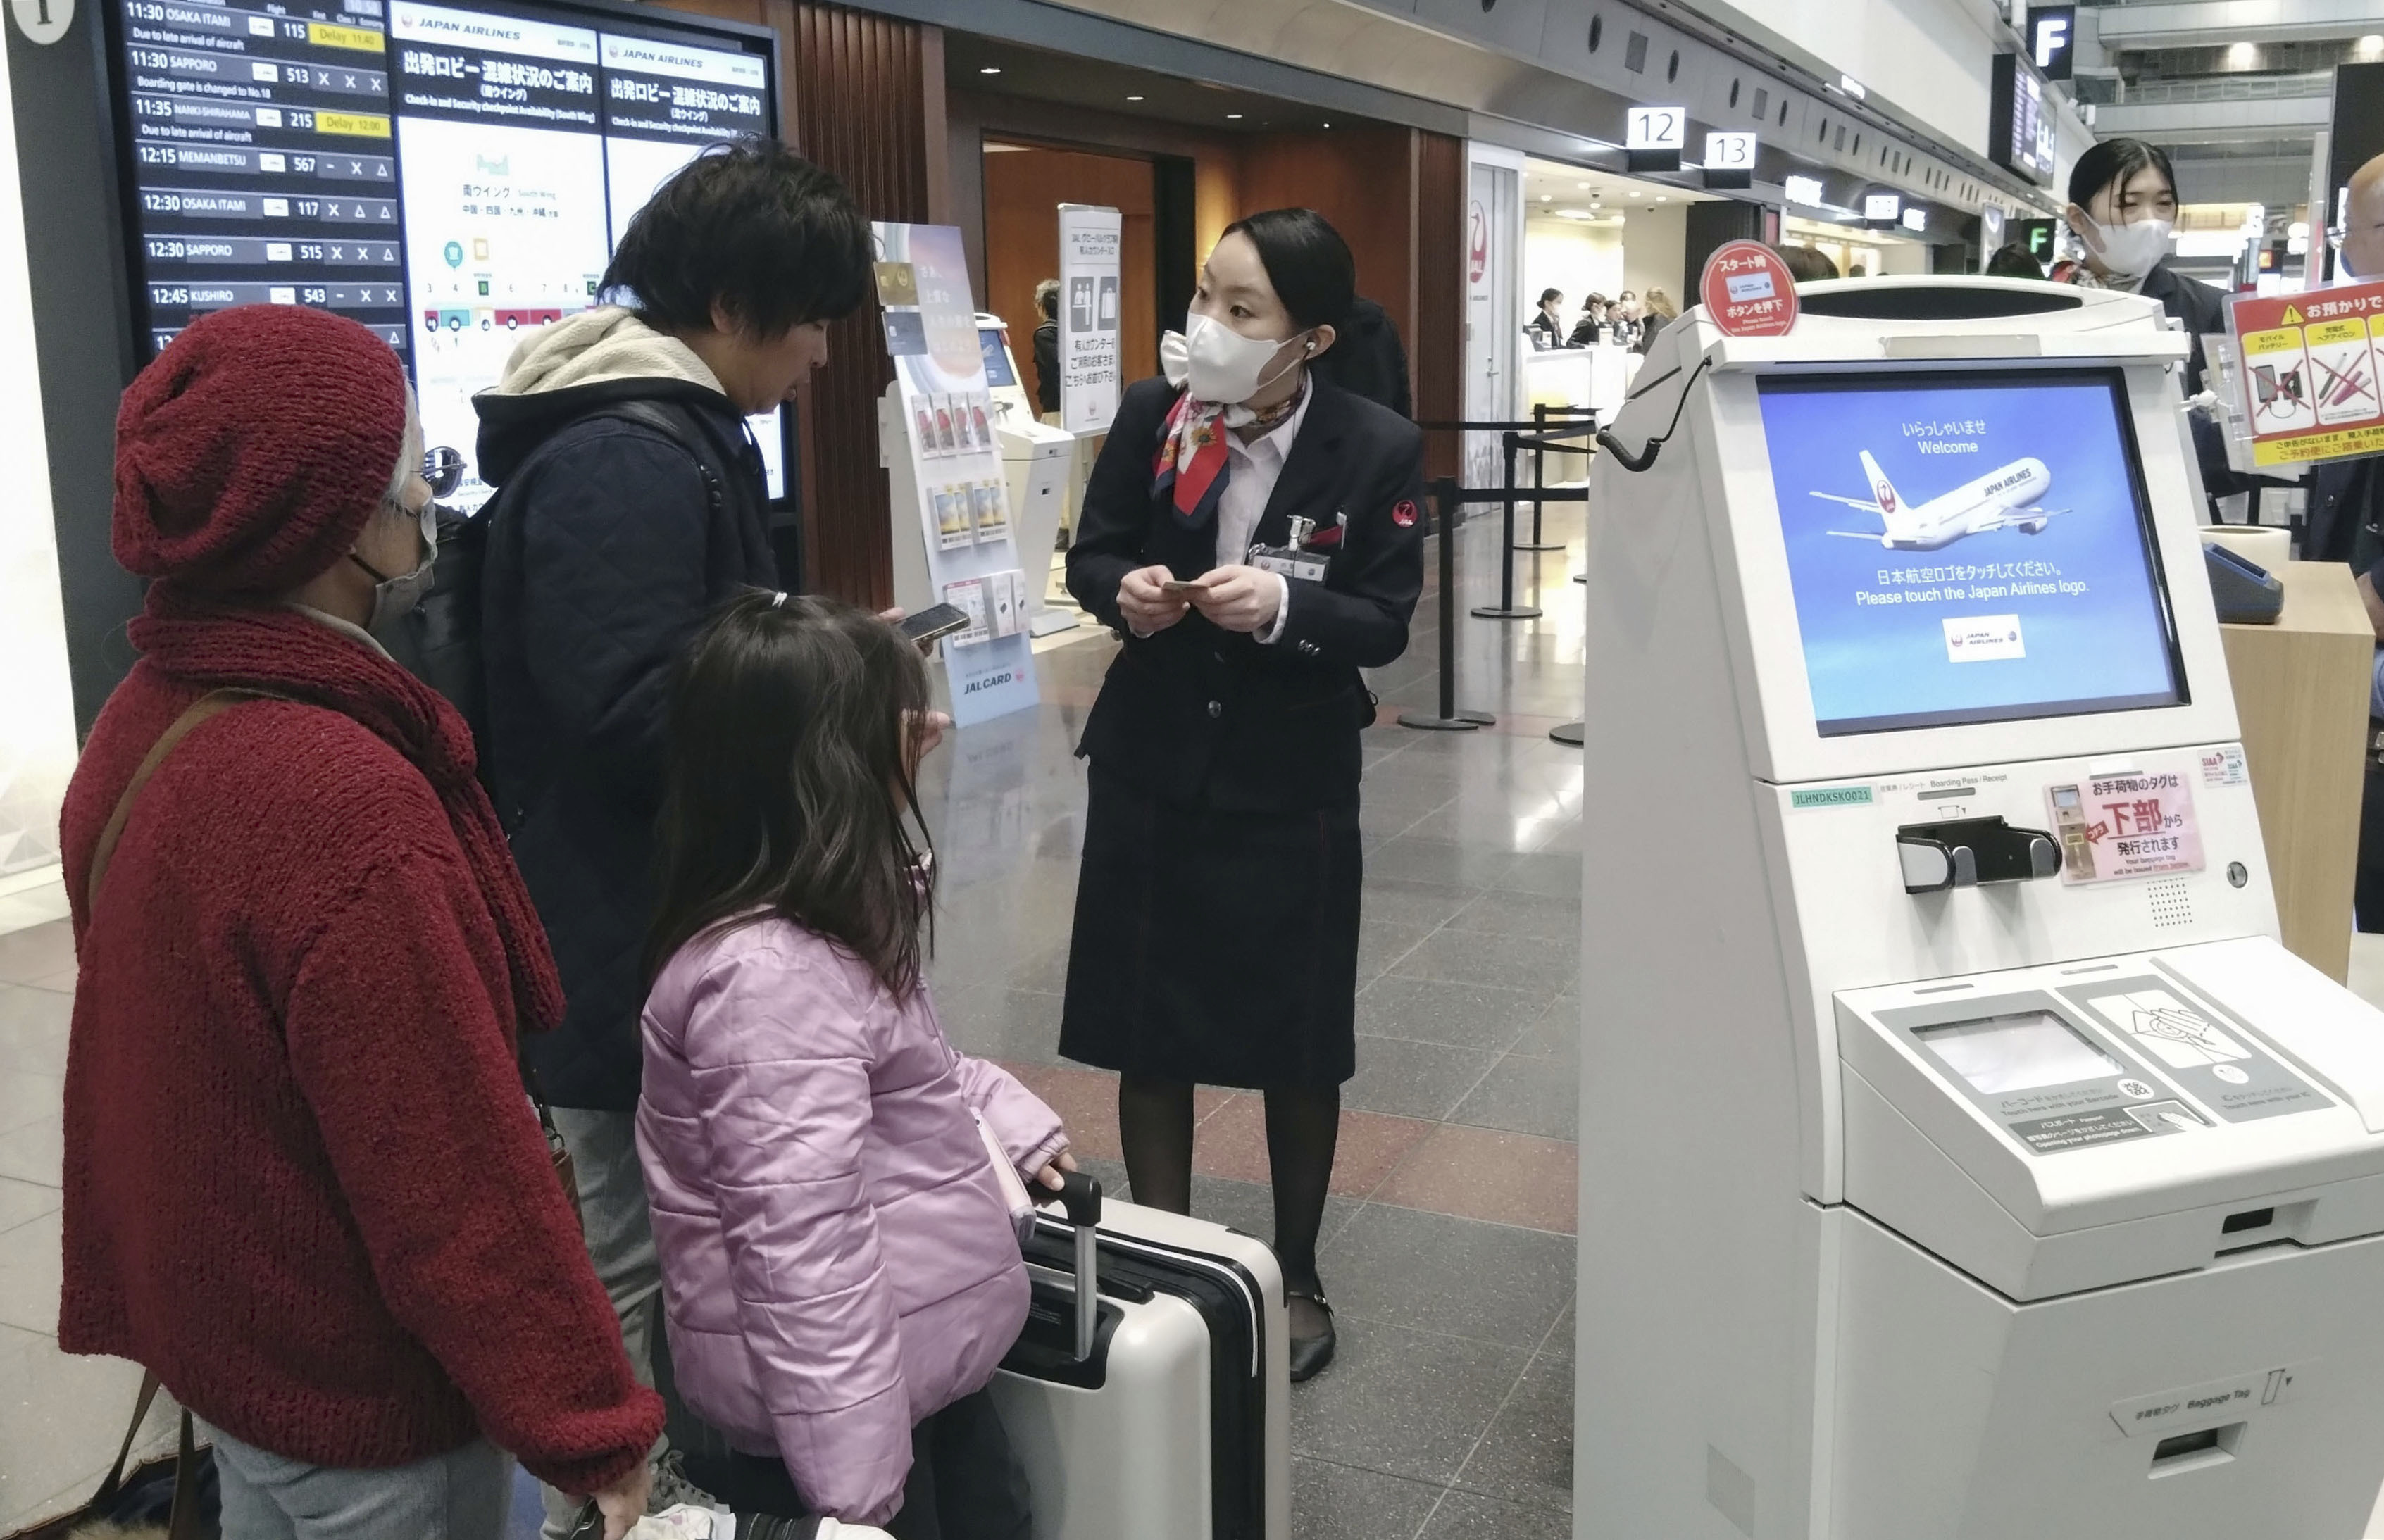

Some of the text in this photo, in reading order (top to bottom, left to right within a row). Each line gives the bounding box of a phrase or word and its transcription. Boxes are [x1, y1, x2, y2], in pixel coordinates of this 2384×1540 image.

[127, 1, 164, 21] 11:30
[166, 8, 201, 24] OSAKA
[202, 13, 231, 27] ITAMI
[284, 23, 306, 39] 115
[319, 29, 346, 43] Delay
[419, 18, 521, 41] JAPAN AIRLINES
[133, 27, 245, 51] Due to late arrival of aircraft
[2035, 20, 2067, 68] F
[132, 50, 309, 84] 11:30 SAPPORO 513
[623, 49, 703, 68] JAPAN AIRLINES
[137, 75, 175, 92] Boarding
[176, 81, 195, 93] gate
[196, 82, 202, 92] is
[204, 82, 237, 97] changed
[238, 87, 247, 96] to
[404, 93, 437, 107] Check-in
[439, 98, 452, 108] and
[453, 99, 482, 113] Security
[482, 102, 519, 114] checkpoint
[137, 99, 172, 116] 11:35
[290, 113, 313, 128] 215
[327, 116, 354, 130] Delay
[358, 120, 381, 132] 12:00
[142, 124, 252, 142] Due to late arrival of aircraft
[1638, 113, 1674, 142] 12
[141, 146, 316, 173] 12:15 MEMANBETSU 567
[1716, 137, 1746, 163] 13
[144, 194, 318, 215] 12:30 OSAKA ITAMI 117
[149, 242, 323, 260] 12:30 SAPPORO 515
[2030, 227, 2048, 254] F
[1718, 254, 1766, 272] スタート時
[153, 289, 326, 304] 12:45 KUSHIRO 543
[1726, 299, 1783, 318] ボタンを押下
[1902, 419, 1986, 437] いらっしゃいませ
[1917, 440, 1978, 454] Welcome
[1983, 468, 2032, 498] JAPAN AIRLINES
[1877, 561, 2061, 586] 日本航空ロゴをタッチしてください。
[1856, 580, 2090, 606] Please touch the Japan Airlines logo.
[1930, 779, 1961, 788] Boarding
[1983, 774, 2007, 783] Receipt
[2092, 775, 2179, 796] お手荷物のタグは
[2117, 836, 2179, 856] 発行されます
[2186, 1389, 2251, 1410] Baggage Tag
